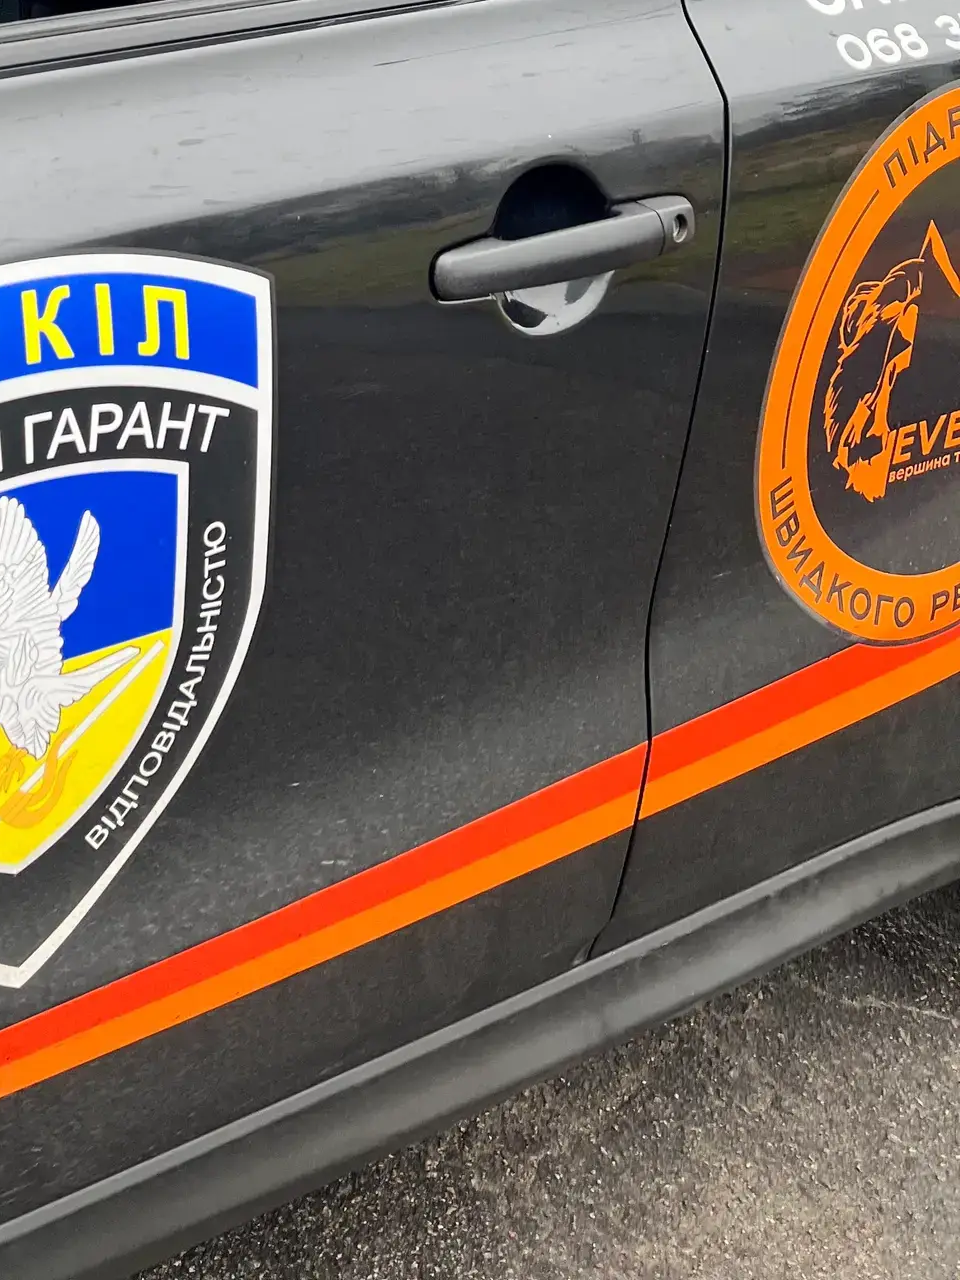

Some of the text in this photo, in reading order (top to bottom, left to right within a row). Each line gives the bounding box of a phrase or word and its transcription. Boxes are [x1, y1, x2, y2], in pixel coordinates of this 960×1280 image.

[837, 13, 960, 69] 068 3
[24, 401, 230, 465] ГАРАНТ
[888, 456, 950, 483] вершина
[770, 476, 915, 628] ШВИДКОГО
[84, 521, 227, 850] ВІДПОВІДАЛЬНІСТЮ
